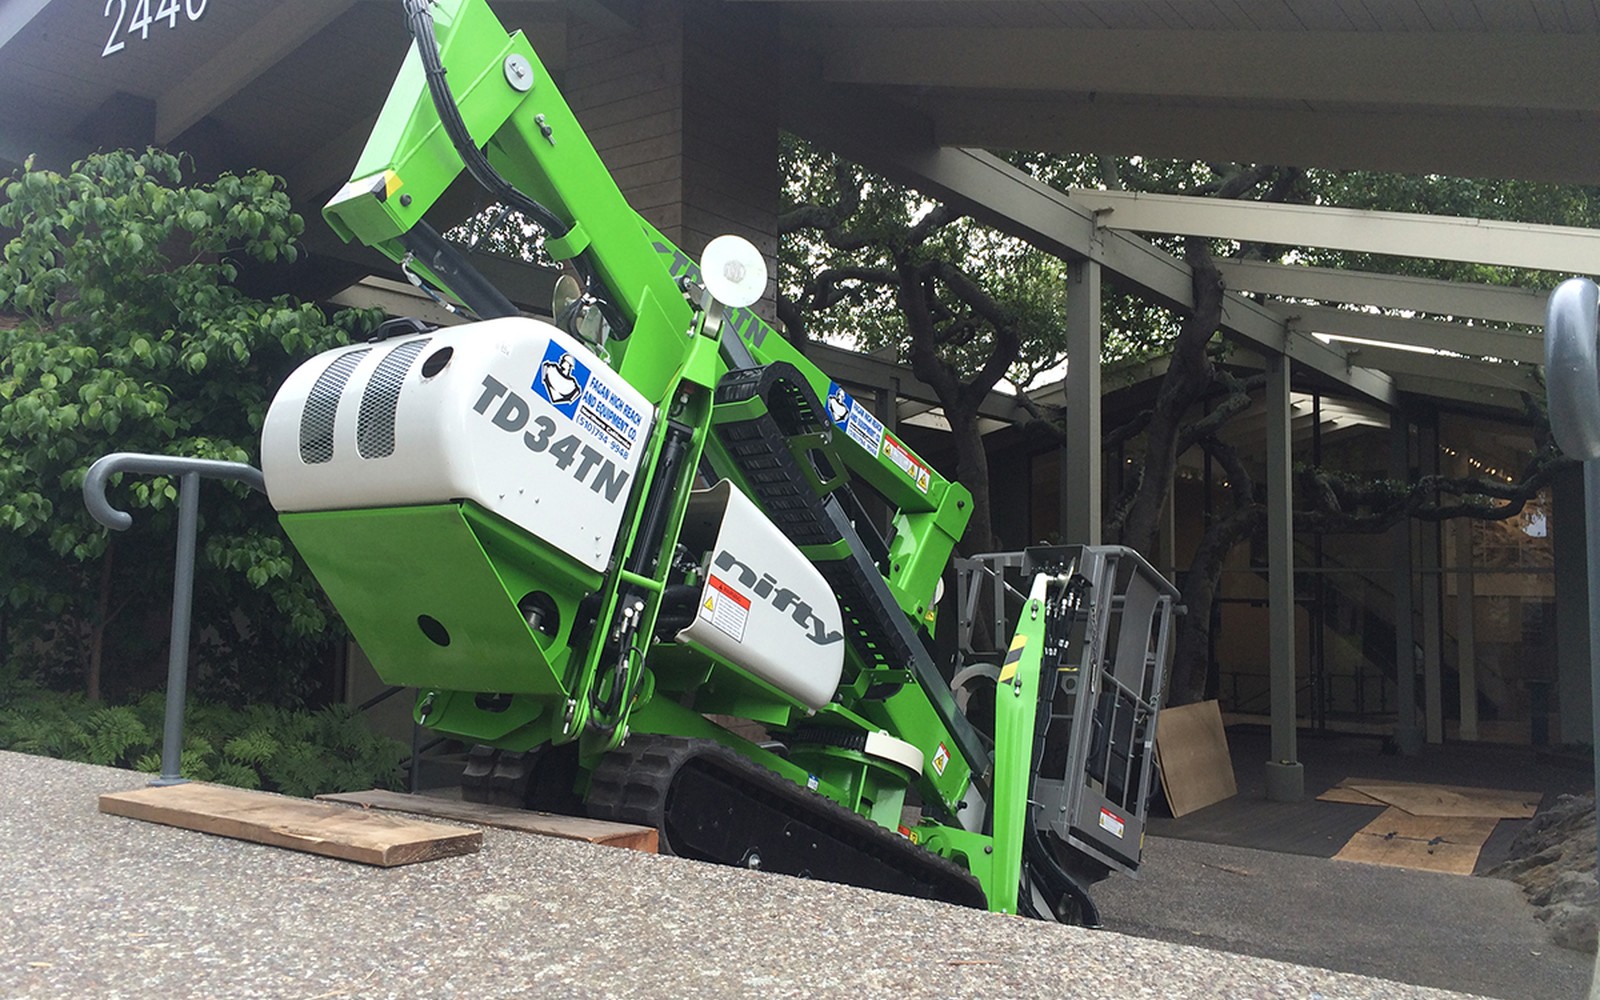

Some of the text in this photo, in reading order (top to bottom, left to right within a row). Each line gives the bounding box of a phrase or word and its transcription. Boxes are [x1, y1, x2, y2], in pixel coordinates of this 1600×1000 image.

[473, 374, 630, 504] TD34TN
[582, 390, 597, 408] AND
[595, 401, 629, 434] EQUIPMENT
[623, 404, 642, 427] REACH
[714, 550, 844, 645] nifty
